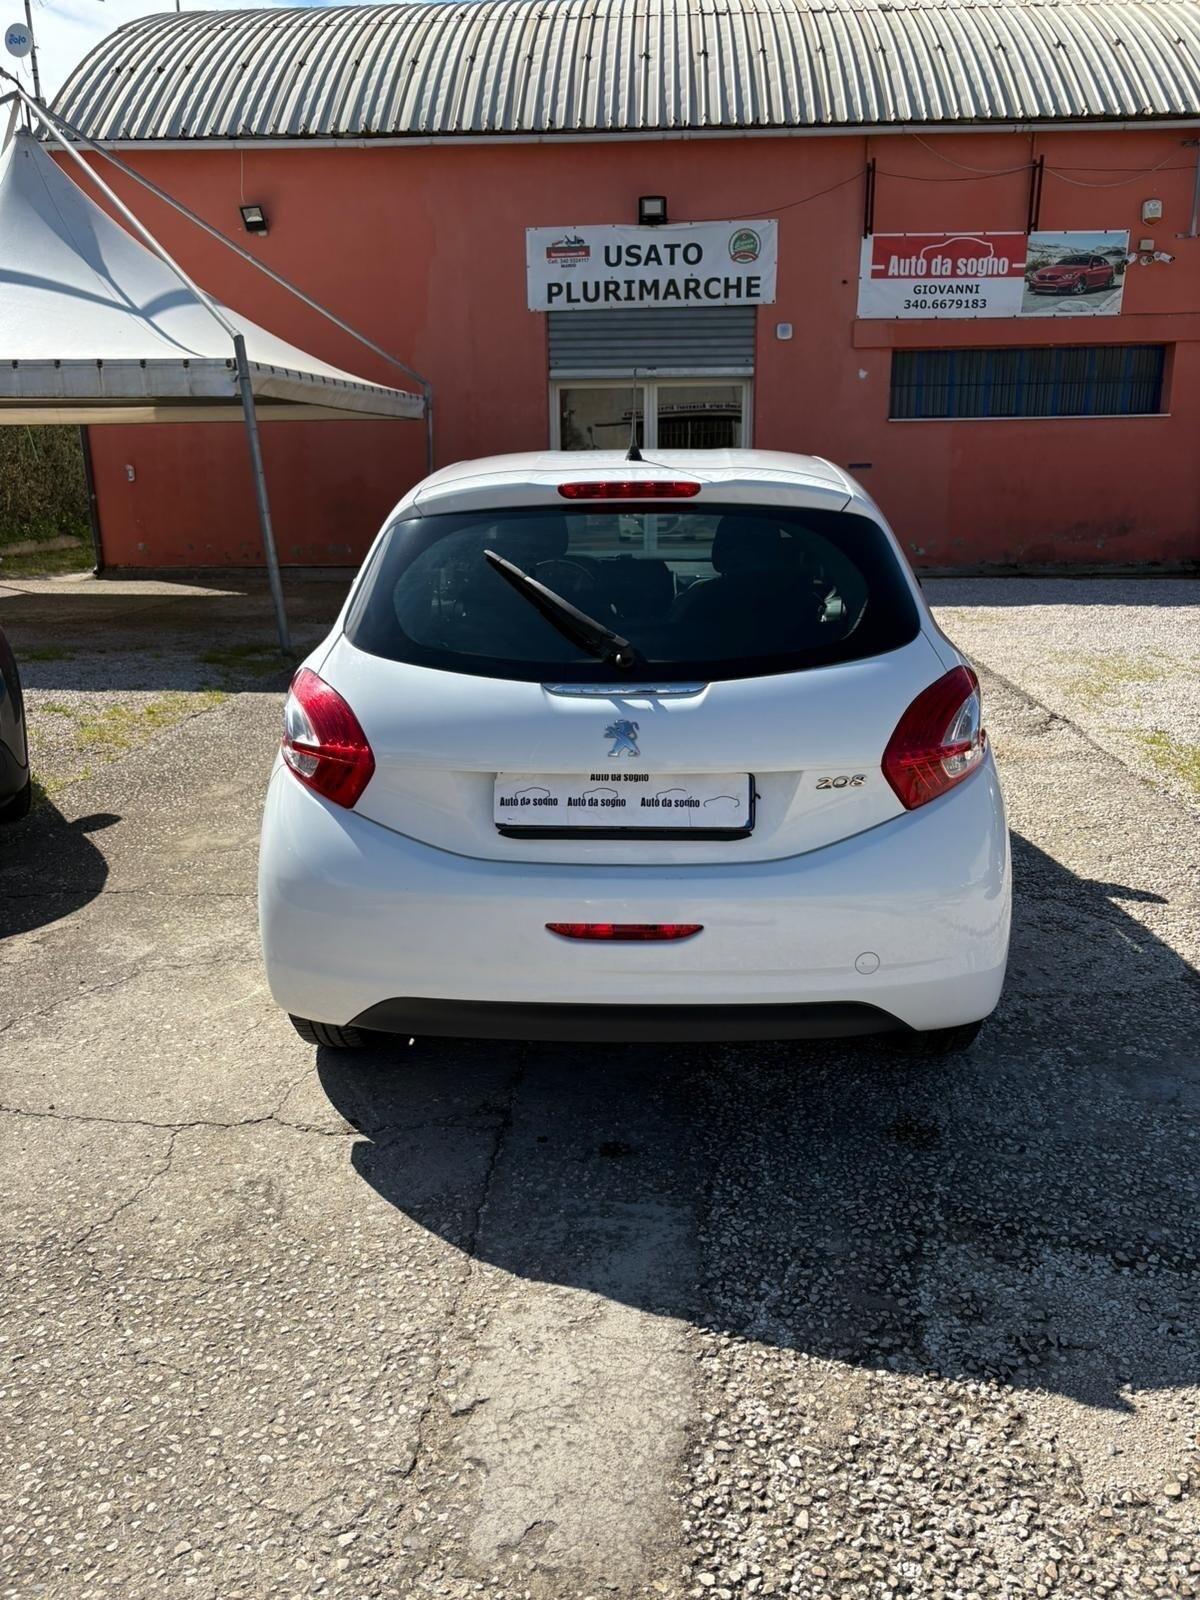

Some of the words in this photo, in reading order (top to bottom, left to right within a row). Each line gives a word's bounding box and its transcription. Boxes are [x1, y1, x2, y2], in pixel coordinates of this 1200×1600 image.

[604, 242, 704, 268] USATO
[888, 255, 926, 277] Auto
[931, 255, 952, 276] da
[956, 257, 1008, 277] sogno
[547, 276, 761, 304] PLURIMARCHE
[913, 284, 980, 295] GIOVANNI
[904, 298, 987, 309] 340.6679183
[816, 773, 867, 790] 208
[500, 796, 519, 807] Auto
[520, 796, 530, 807] da
[567, 797, 586, 807] Auto
[588, 797, 599, 807] da
[600, 797, 626, 808] sogno
[640, 797, 660, 807] Auto
[661, 797, 672, 807] da
